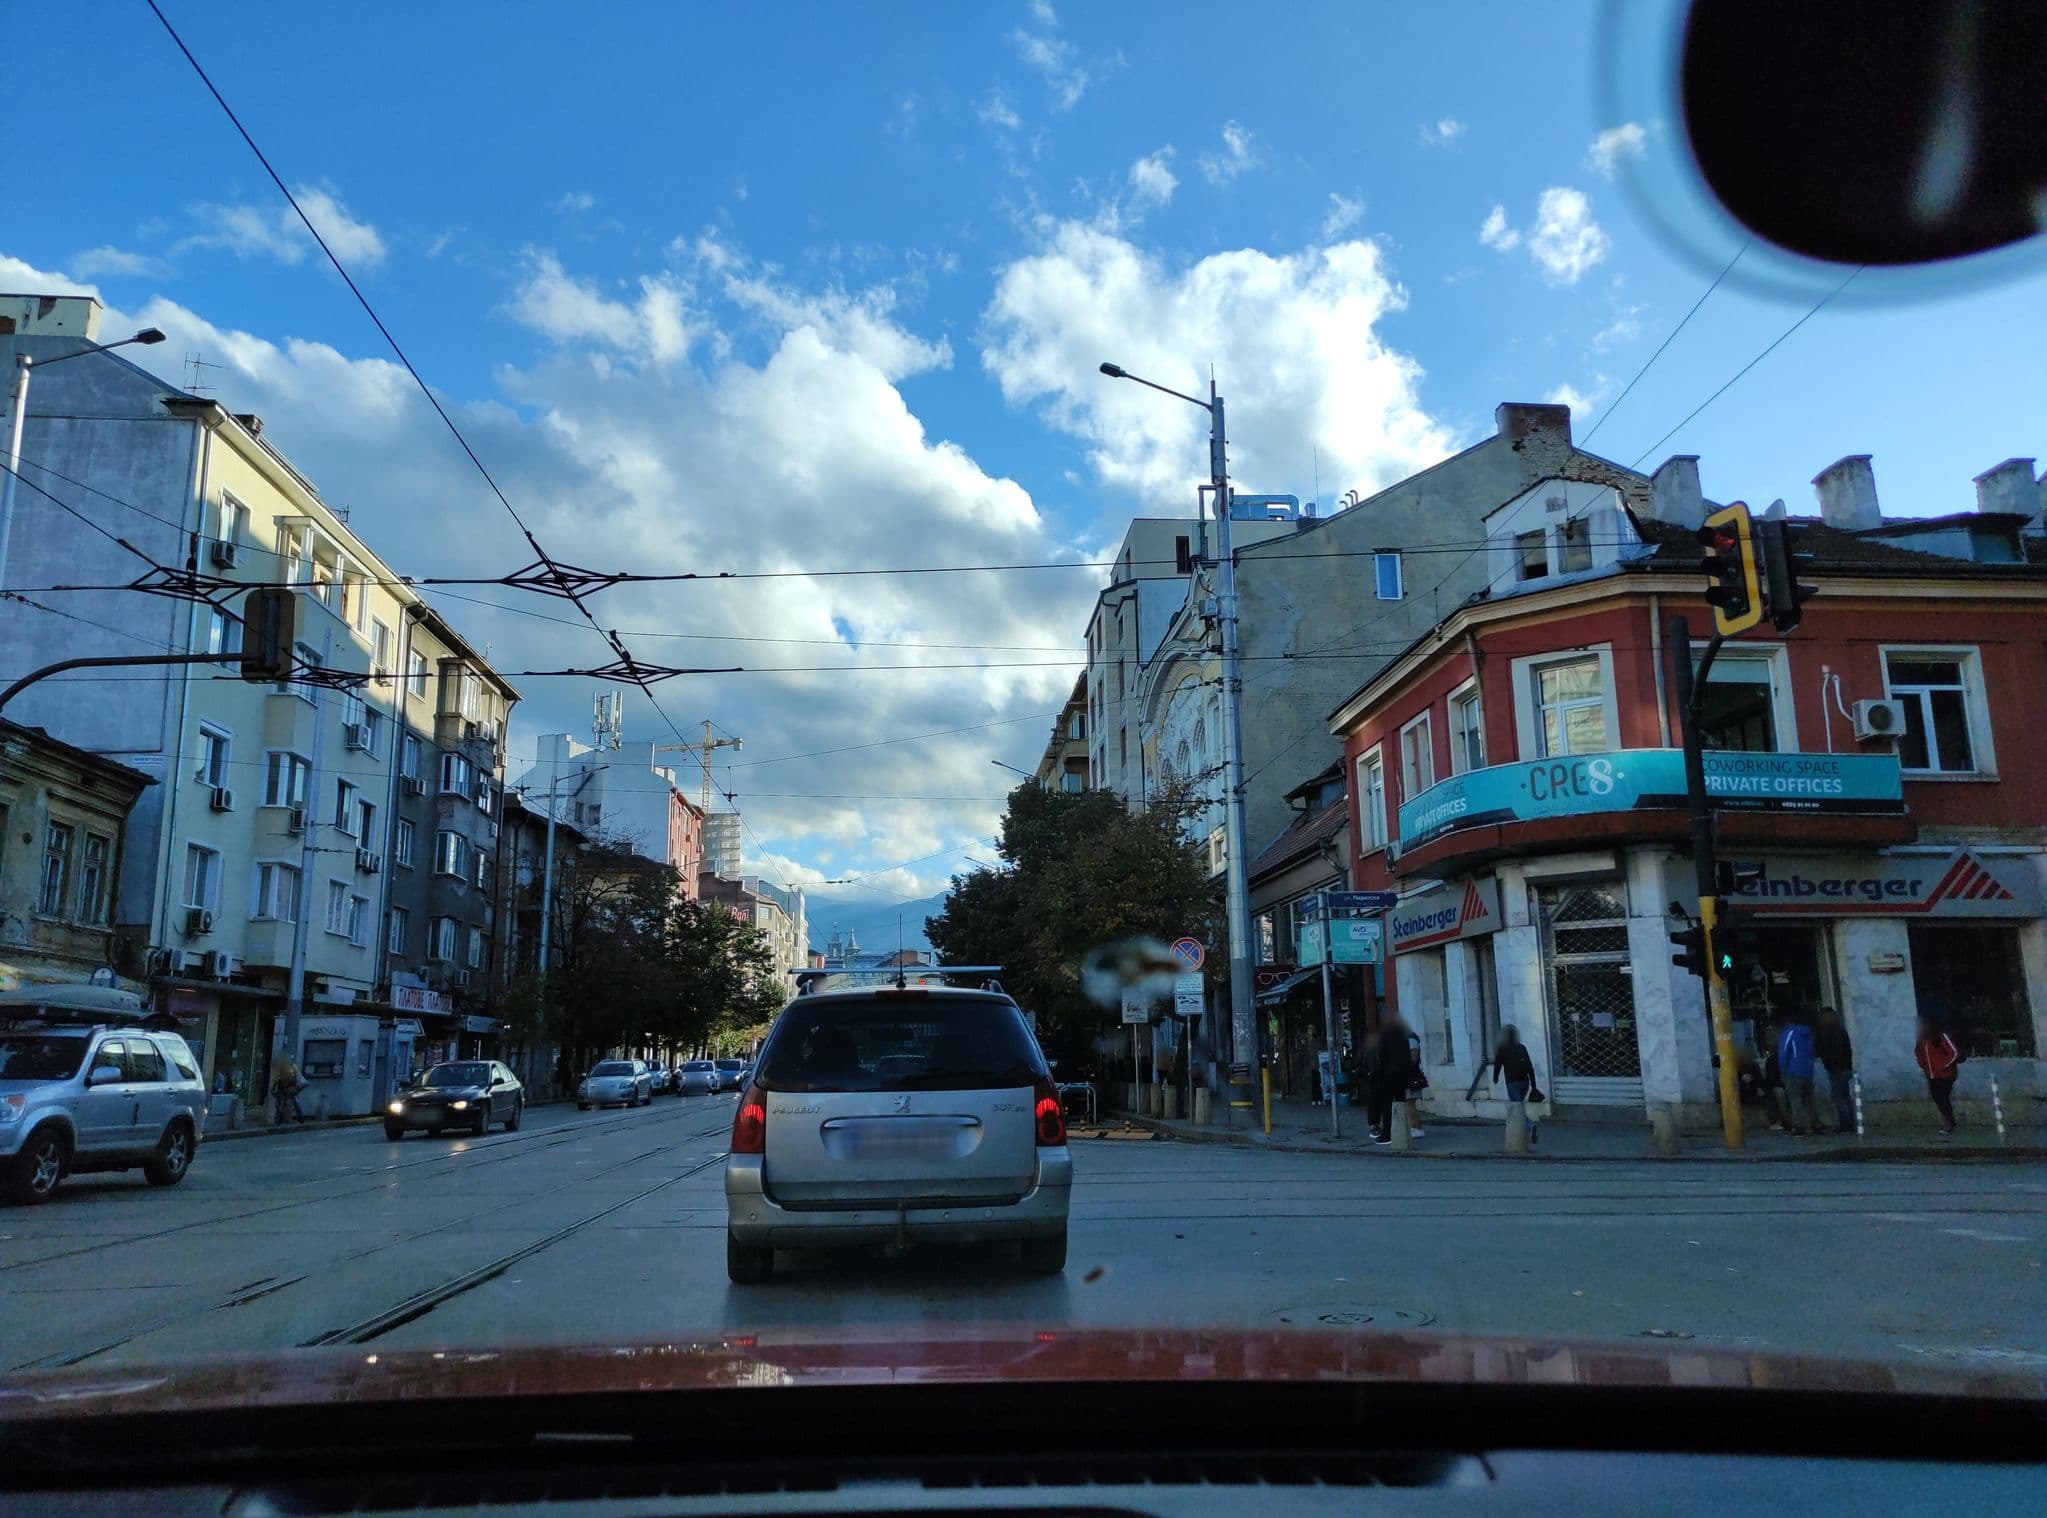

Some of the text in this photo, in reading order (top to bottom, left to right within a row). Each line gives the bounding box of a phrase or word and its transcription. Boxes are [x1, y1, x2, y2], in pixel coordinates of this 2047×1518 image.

[1797, 760, 1840, 775] SPACE
[1774, 777, 1843, 793] OFFICES
[1435, 798, 1467, 821] OFFICES
[1393, 907, 1457, 938] Steinberger
